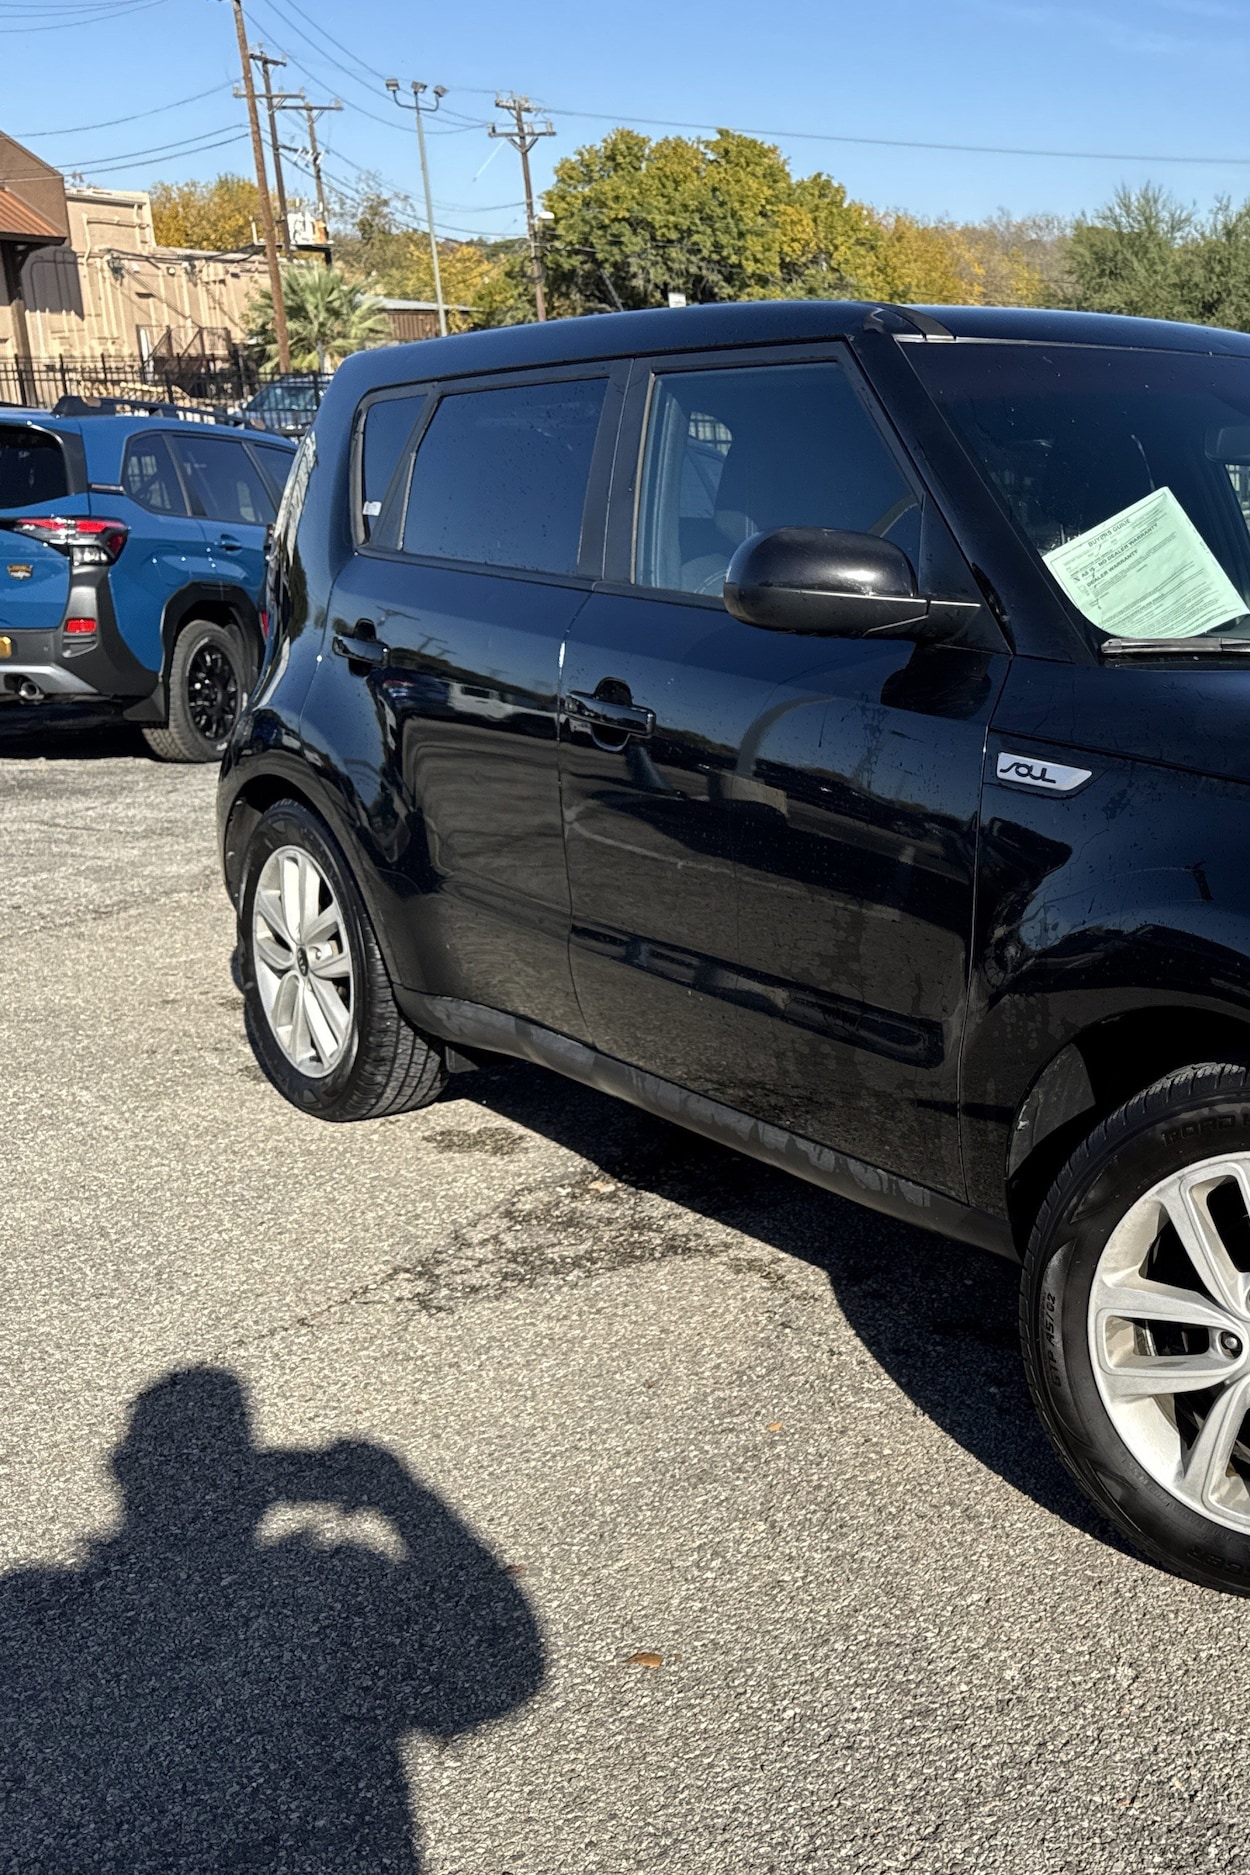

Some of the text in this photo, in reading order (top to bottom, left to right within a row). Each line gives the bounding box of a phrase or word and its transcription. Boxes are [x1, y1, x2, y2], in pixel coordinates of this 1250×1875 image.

[1107, 544, 1129, 561] DEALER
[1129, 522, 1158, 546] WARRANTY
[1086, 570, 1109, 588] DEALER
[1108, 549, 1138, 572] WARRANTY
